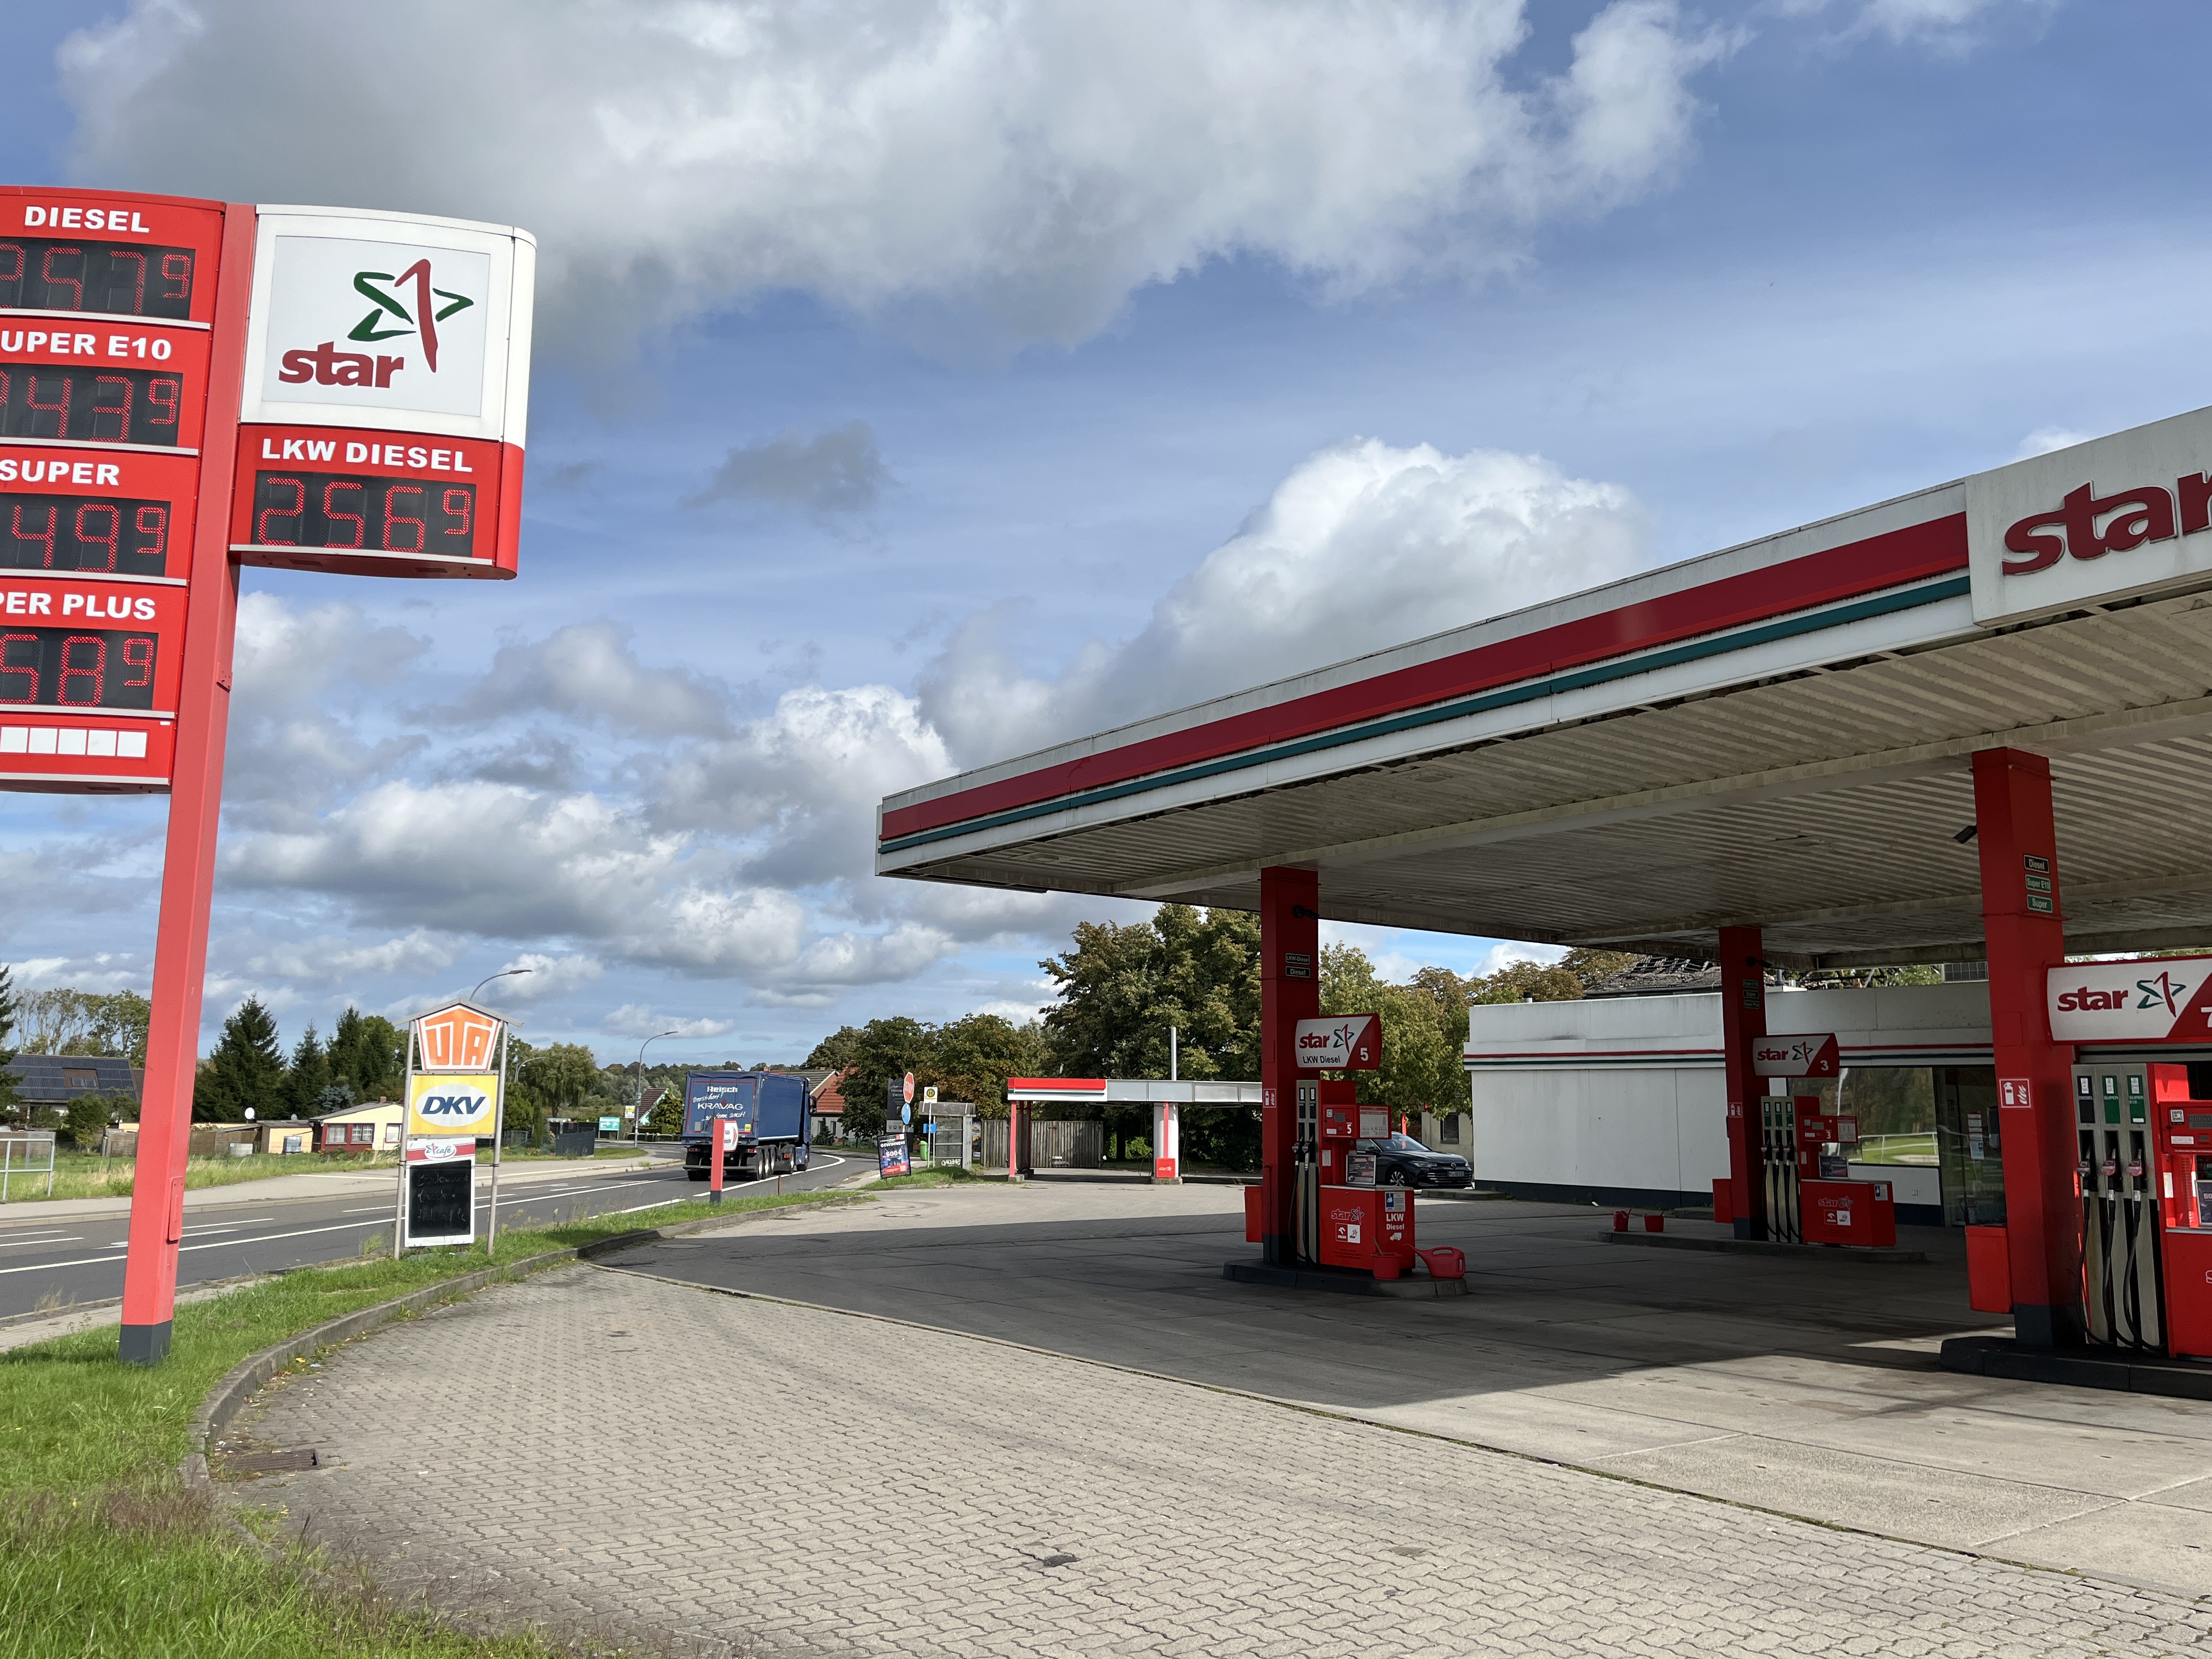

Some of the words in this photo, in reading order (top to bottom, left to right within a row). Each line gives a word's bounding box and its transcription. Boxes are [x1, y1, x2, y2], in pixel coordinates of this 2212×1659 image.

[24, 206, 150, 233] DIESEL
[0, 330, 96, 356] UPER
[108, 335, 172, 360] E10
[278, 341, 404, 388] star
[0, 371, 178, 442] 439
[262, 438, 336, 463] LKW
[346, 443, 473, 473] DIESEL
[0, 459, 120, 486] SUPER
[63, 594, 156, 620] PLUS
[2028, 859, 2045, 871] Diesel
[2027, 878, 2040, 888] Super
[2041, 881, 2050, 889] E10
[2032, 898, 2047, 910] Super
[2057, 986, 2128, 1012] star
[425, 1008, 493, 1065] UTA
[1299, 1032, 1330, 1048] star
[1360, 1047, 1369, 1061] 5
[1302, 1056, 1318, 1064] LKW
[1320, 1056, 1341, 1064] Diesel
[1757, 1047, 1788, 1060] star
[1820, 1060, 1829, 1071] 3
[905, 1080, 913, 1094] STOP
[421, 1096, 486, 1115] DKV
[1347, 1124, 1352, 1134] 5
[436, 1146, 452, 1156] café
[1331, 1209, 1351, 1221] star
[1386, 1214, 1404, 1222] LKW
